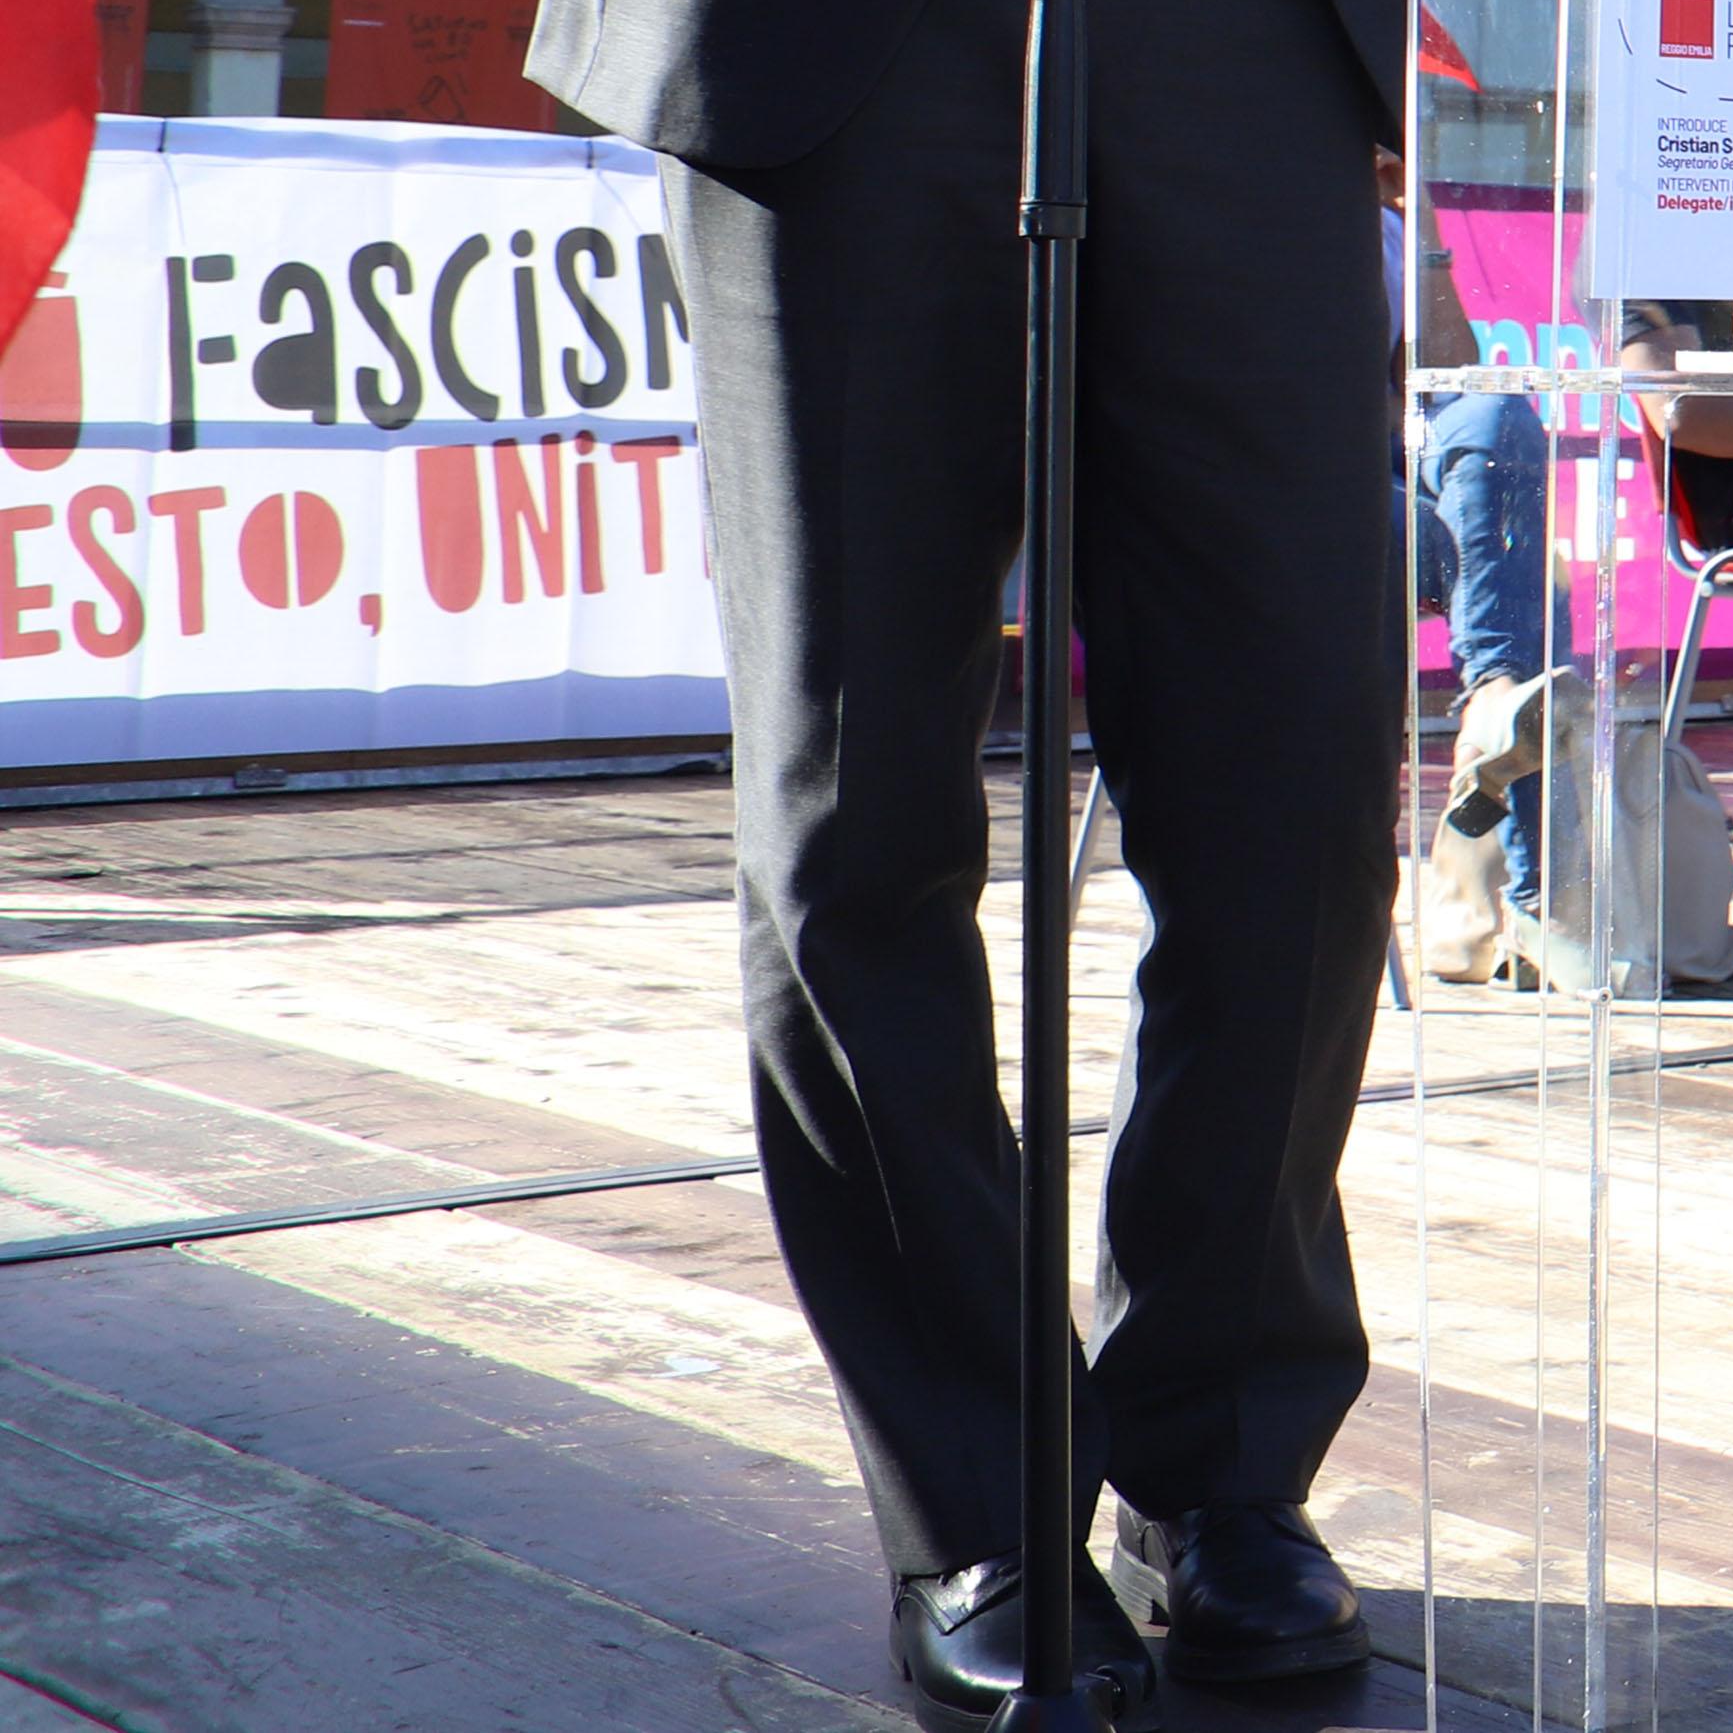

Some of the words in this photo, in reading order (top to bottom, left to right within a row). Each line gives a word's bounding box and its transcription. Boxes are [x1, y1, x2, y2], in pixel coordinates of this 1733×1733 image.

[1661, 43, 1687, 55] REGGIO
[1688, 45, 1713, 56] EMILIA
[1657, 118, 1728, 133] INTRODUCE
[1657, 135, 1719, 154] Cristian
[1657, 155, 1719, 172] Segretario
[1657, 177, 1730, 192] INTERVENTI
[1657, 194, 1733, 214] Delegate/i
